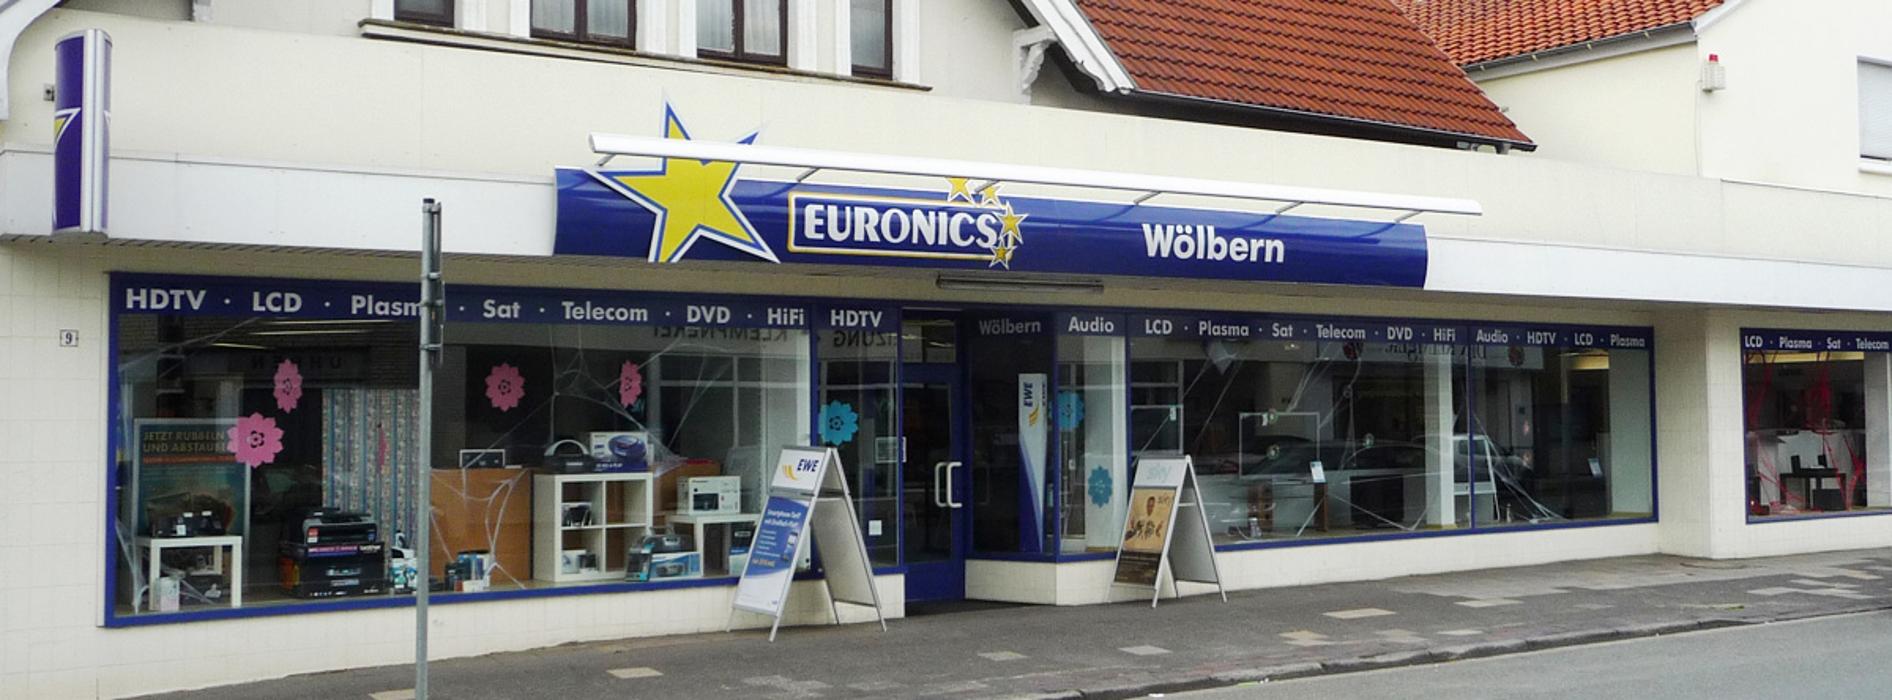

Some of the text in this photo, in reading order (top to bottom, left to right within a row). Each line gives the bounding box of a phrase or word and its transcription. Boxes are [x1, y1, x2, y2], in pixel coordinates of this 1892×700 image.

[803, 204, 998, 249] EURONICS
[1141, 222, 1285, 263] Wölbern
[126, 287, 805, 326] HDTV LCD Plasm Sat Telecom DVD HiFi
[830, 309, 883, 328] HDTV
[978, 317, 1042, 335] Wölbern
[1068, 316, 1115, 333] Audio
[64, 331, 73, 345] 9
[1145, 318, 1457, 343] LCD Plasma Sat Telecom DVD HiFi
[1475, 328, 1646, 348] Audio HDTV LCD Plasma
[1744, 335, 1890, 350] LCD Plasma Sat Telecom
[1023, 381, 1034, 408] EWE
[797, 458, 820, 473] EWE
